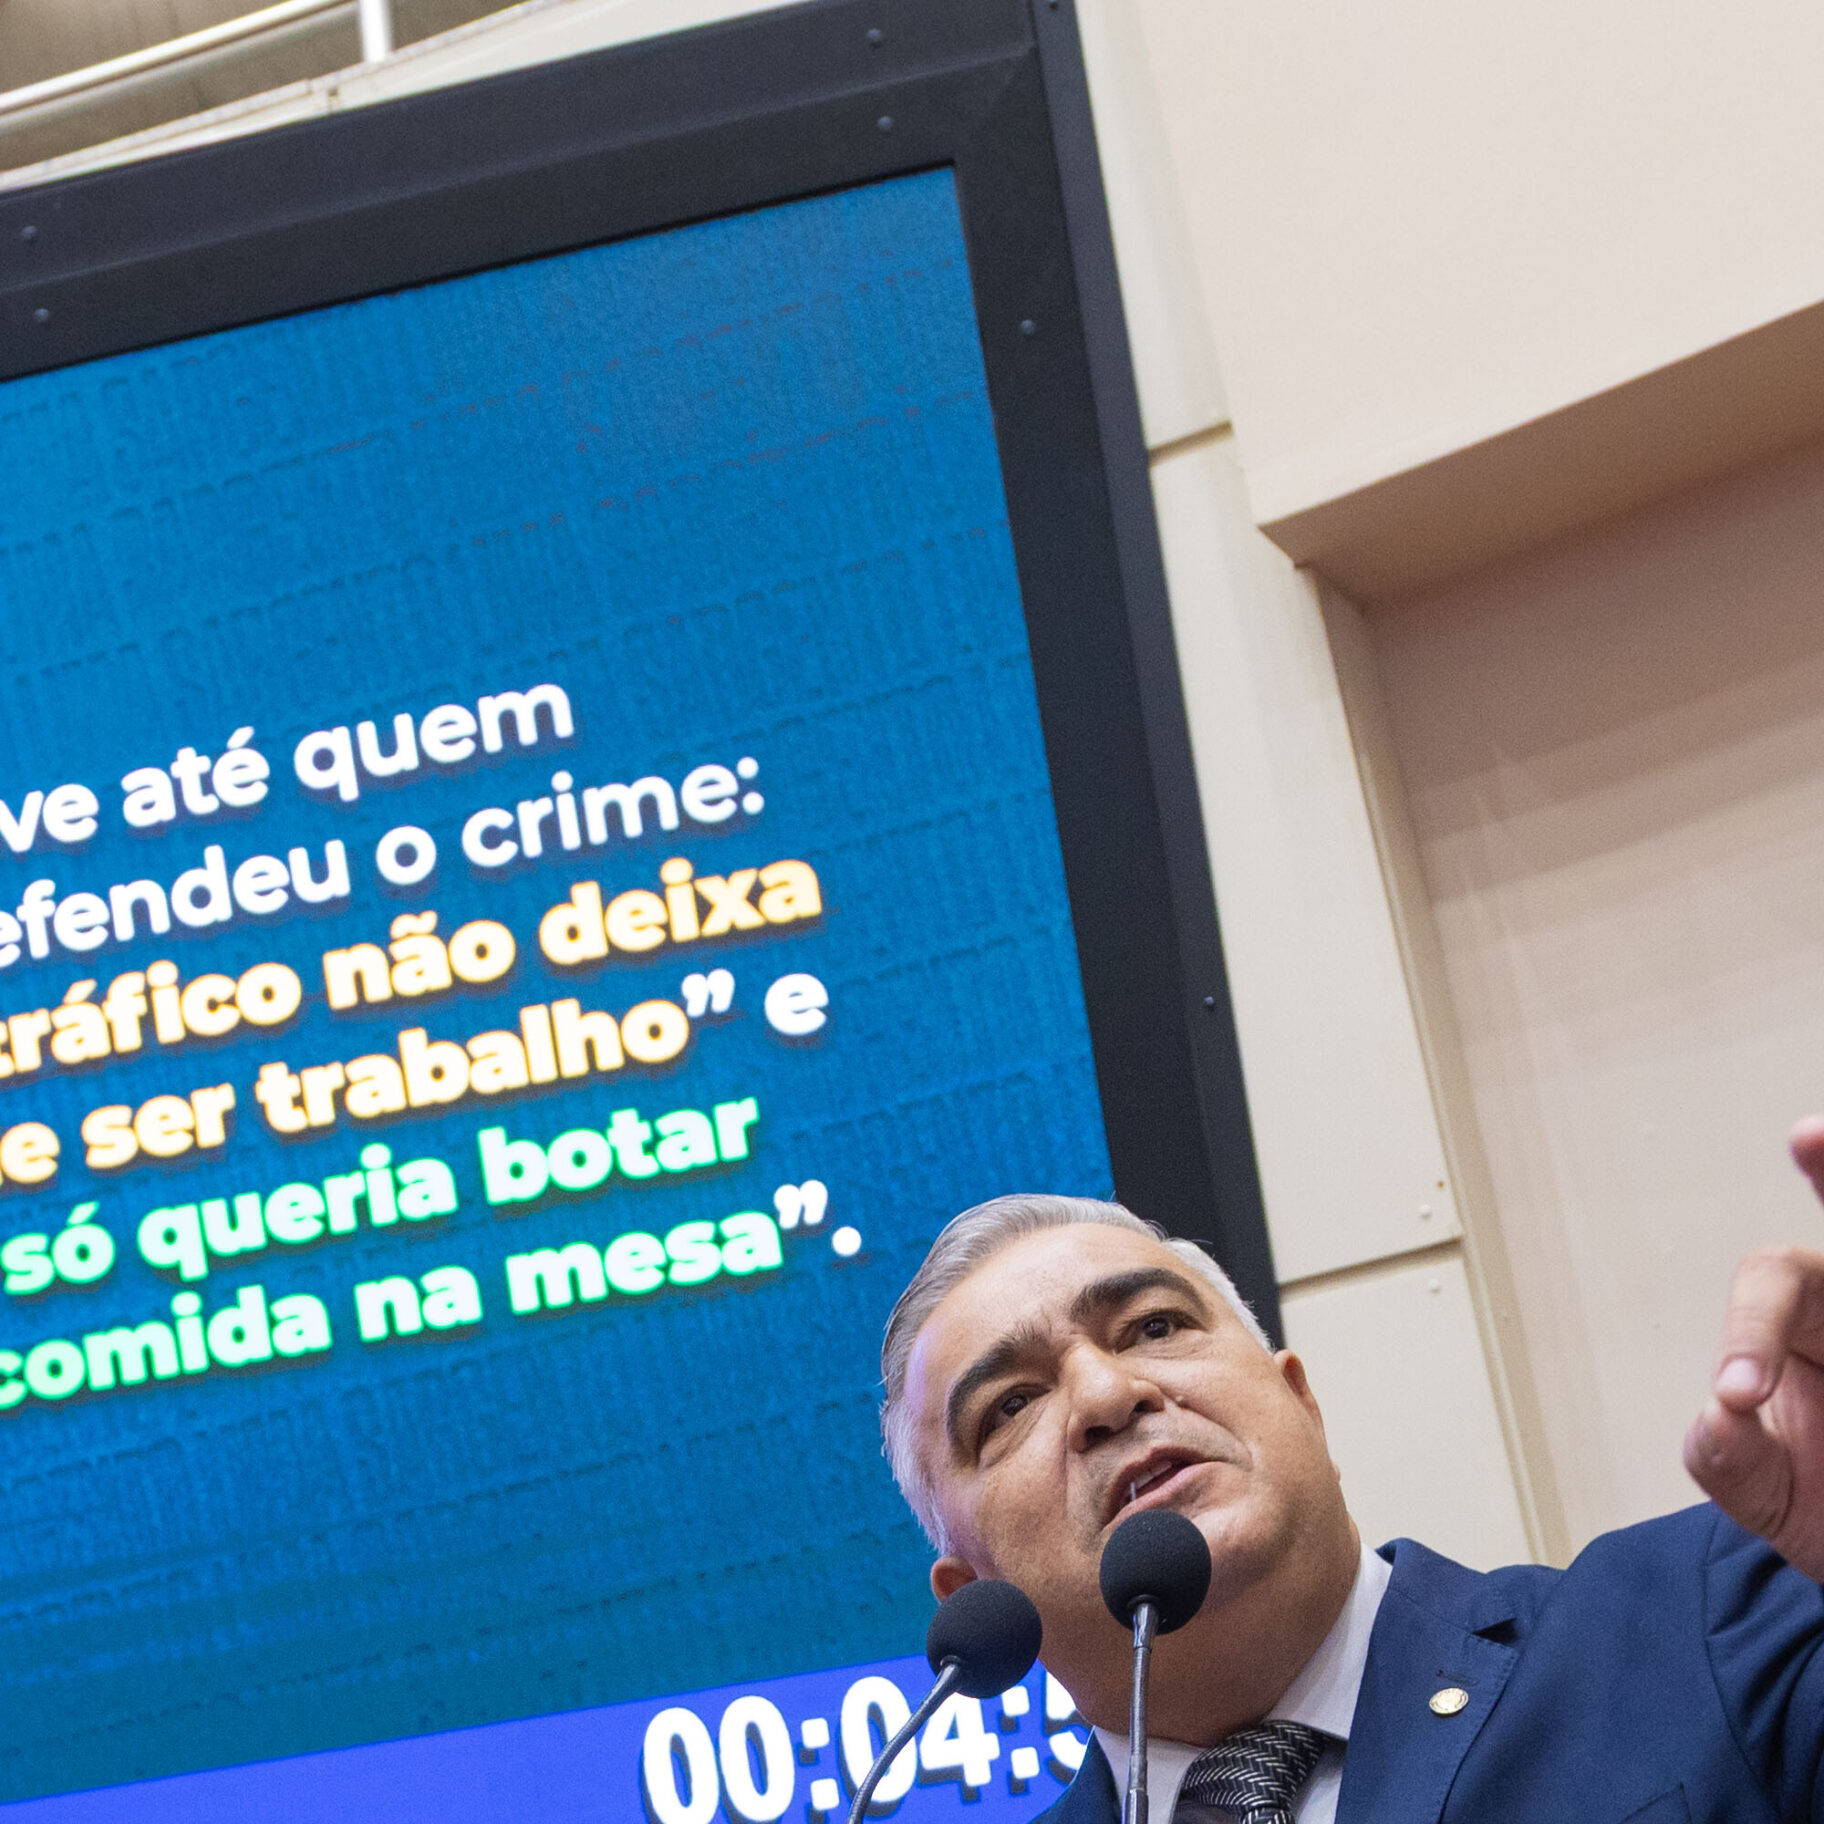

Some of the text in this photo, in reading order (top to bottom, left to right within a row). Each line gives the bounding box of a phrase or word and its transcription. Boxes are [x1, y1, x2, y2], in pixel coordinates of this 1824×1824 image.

[120, 727, 271, 828] até
[293, 684, 574, 802] quem
[375, 825, 437, 886] o
[461, 757, 765, 868] crime:
[322, 910, 516, 1009] não
[539, 858, 822, 965] deixa
[81, 1083, 236, 1168] ser
[763, 973, 829, 1036] e
[136, 1141, 460, 1282] queria
[476, 1096, 760, 1206] botar
[352, 1264, 484, 1343] na
